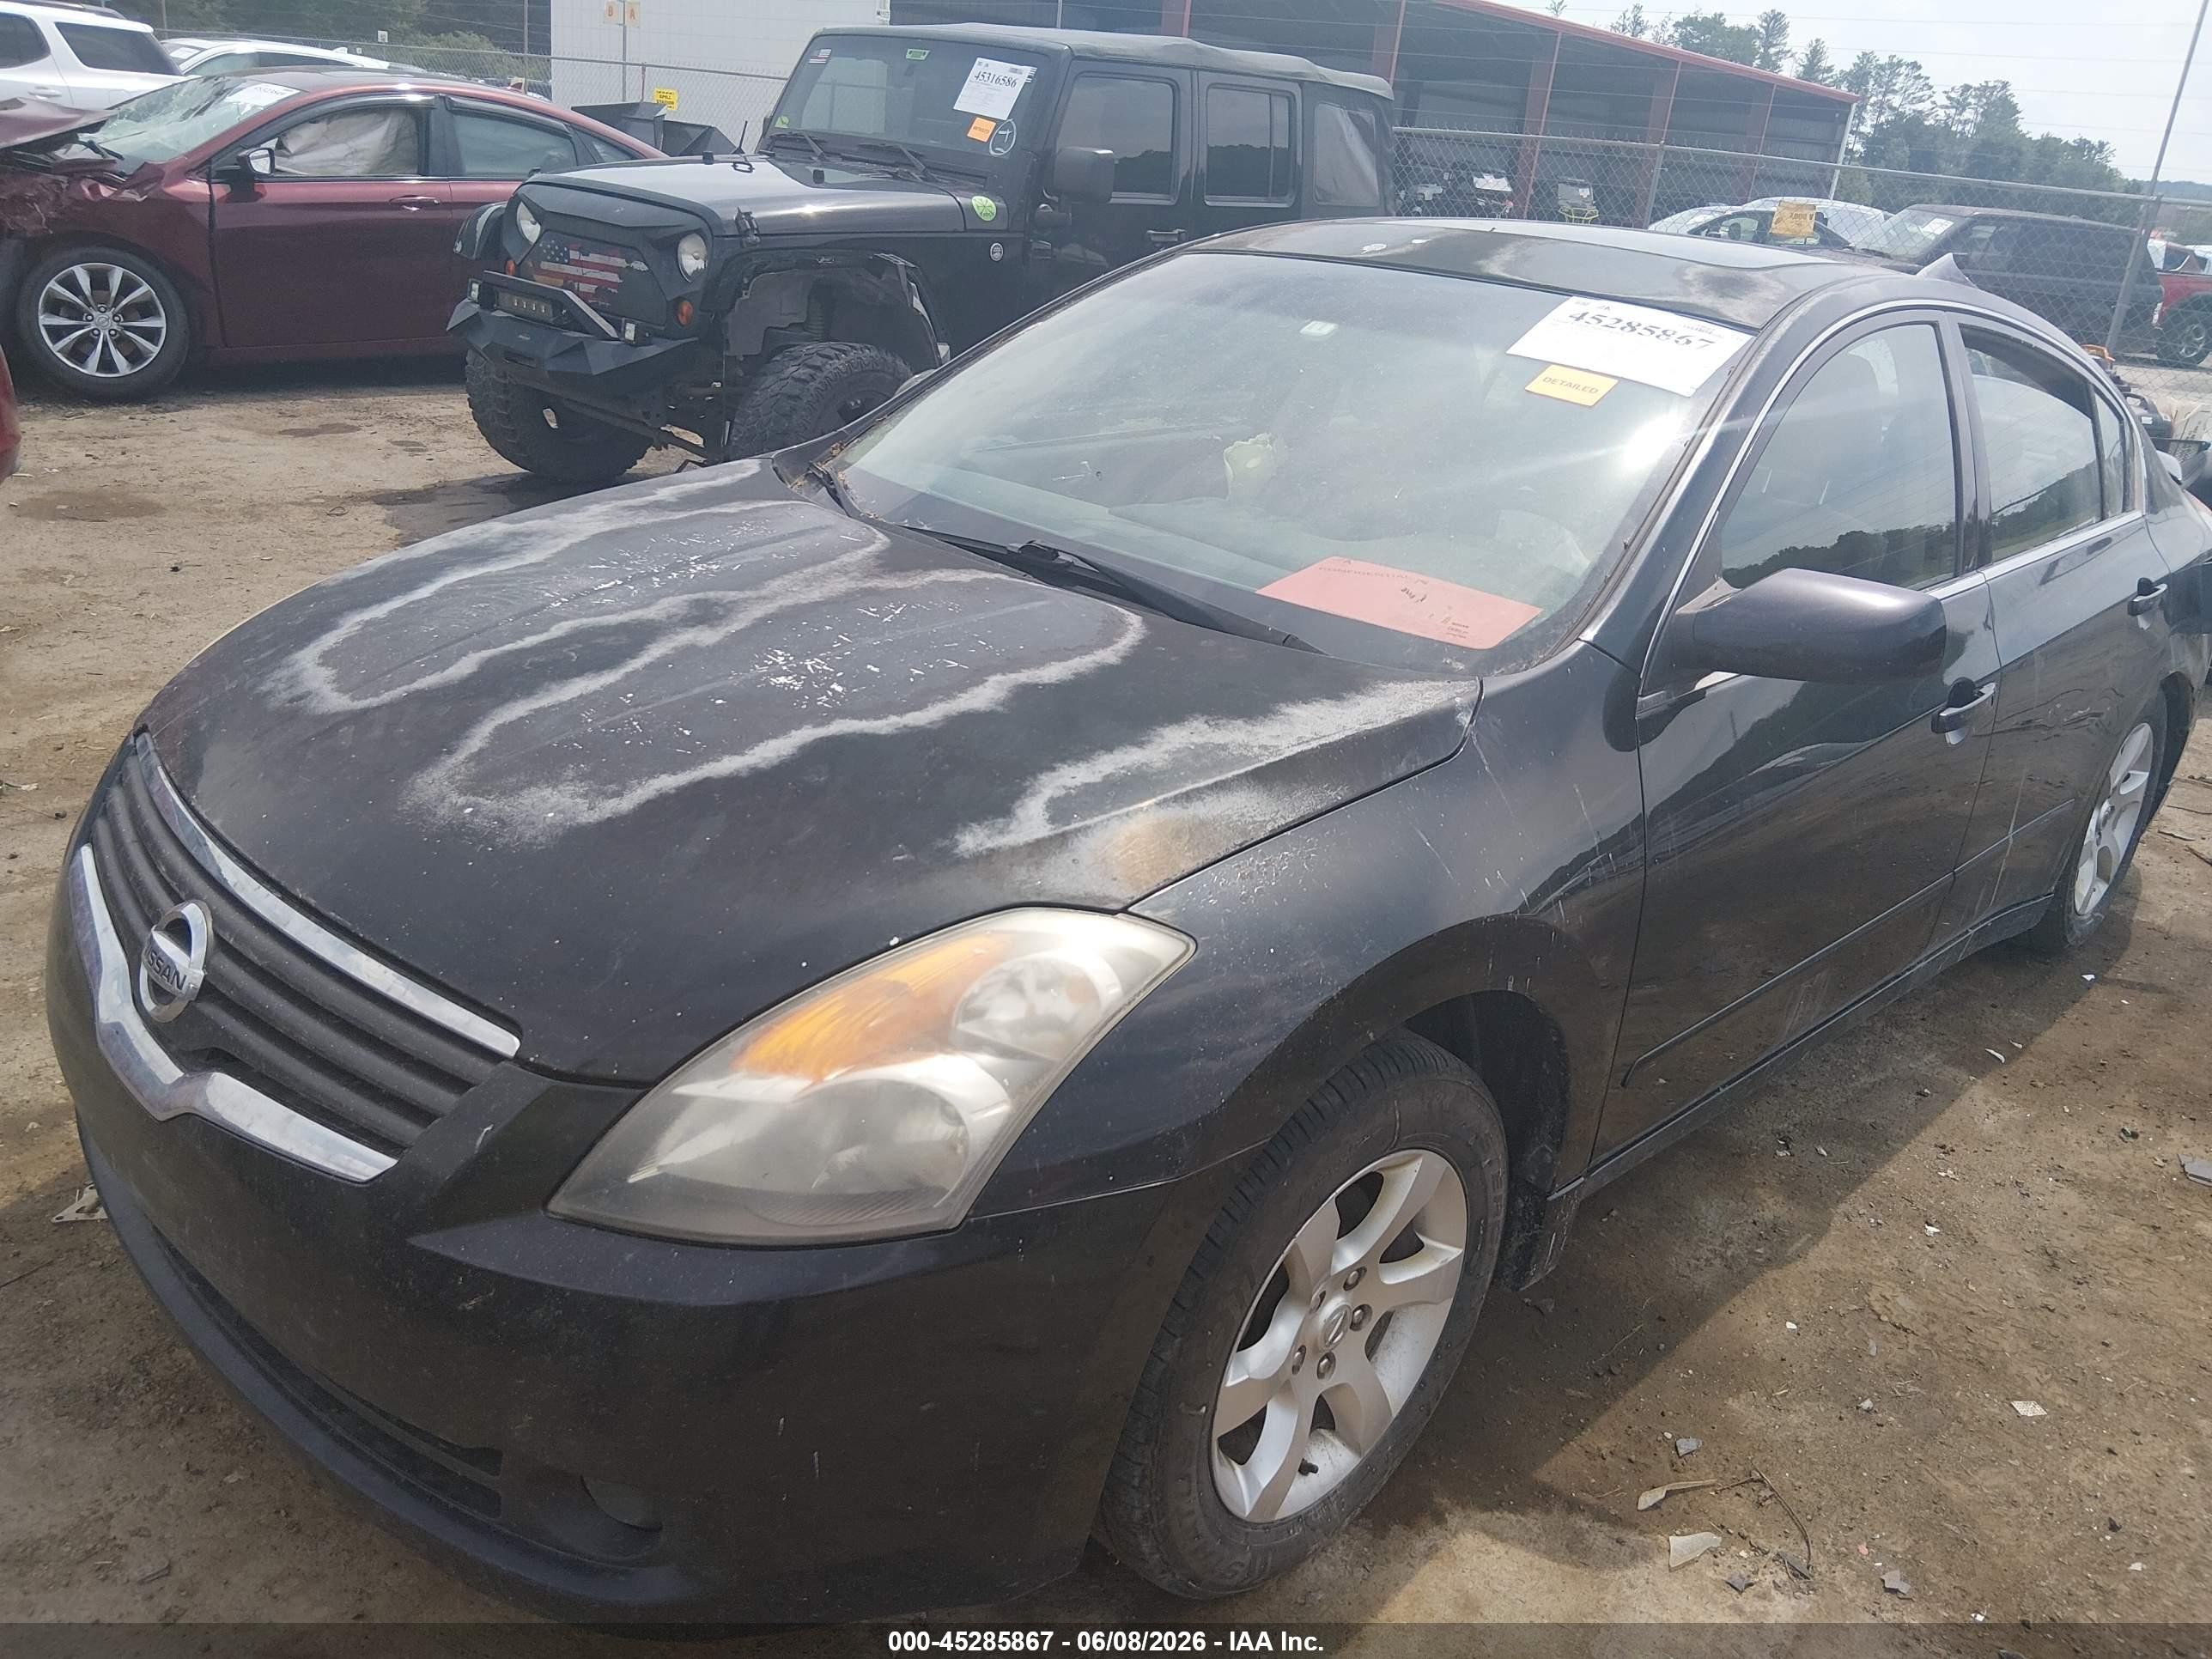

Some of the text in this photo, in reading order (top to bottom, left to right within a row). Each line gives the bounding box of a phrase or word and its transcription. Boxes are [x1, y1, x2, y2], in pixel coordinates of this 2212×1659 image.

[975, 70, 1018, 88] 45316586
[1568, 311, 1717, 350] 45285867
[1542, 377, 1599, 395] DETAILED
[147, 948, 187, 991] SSAN
